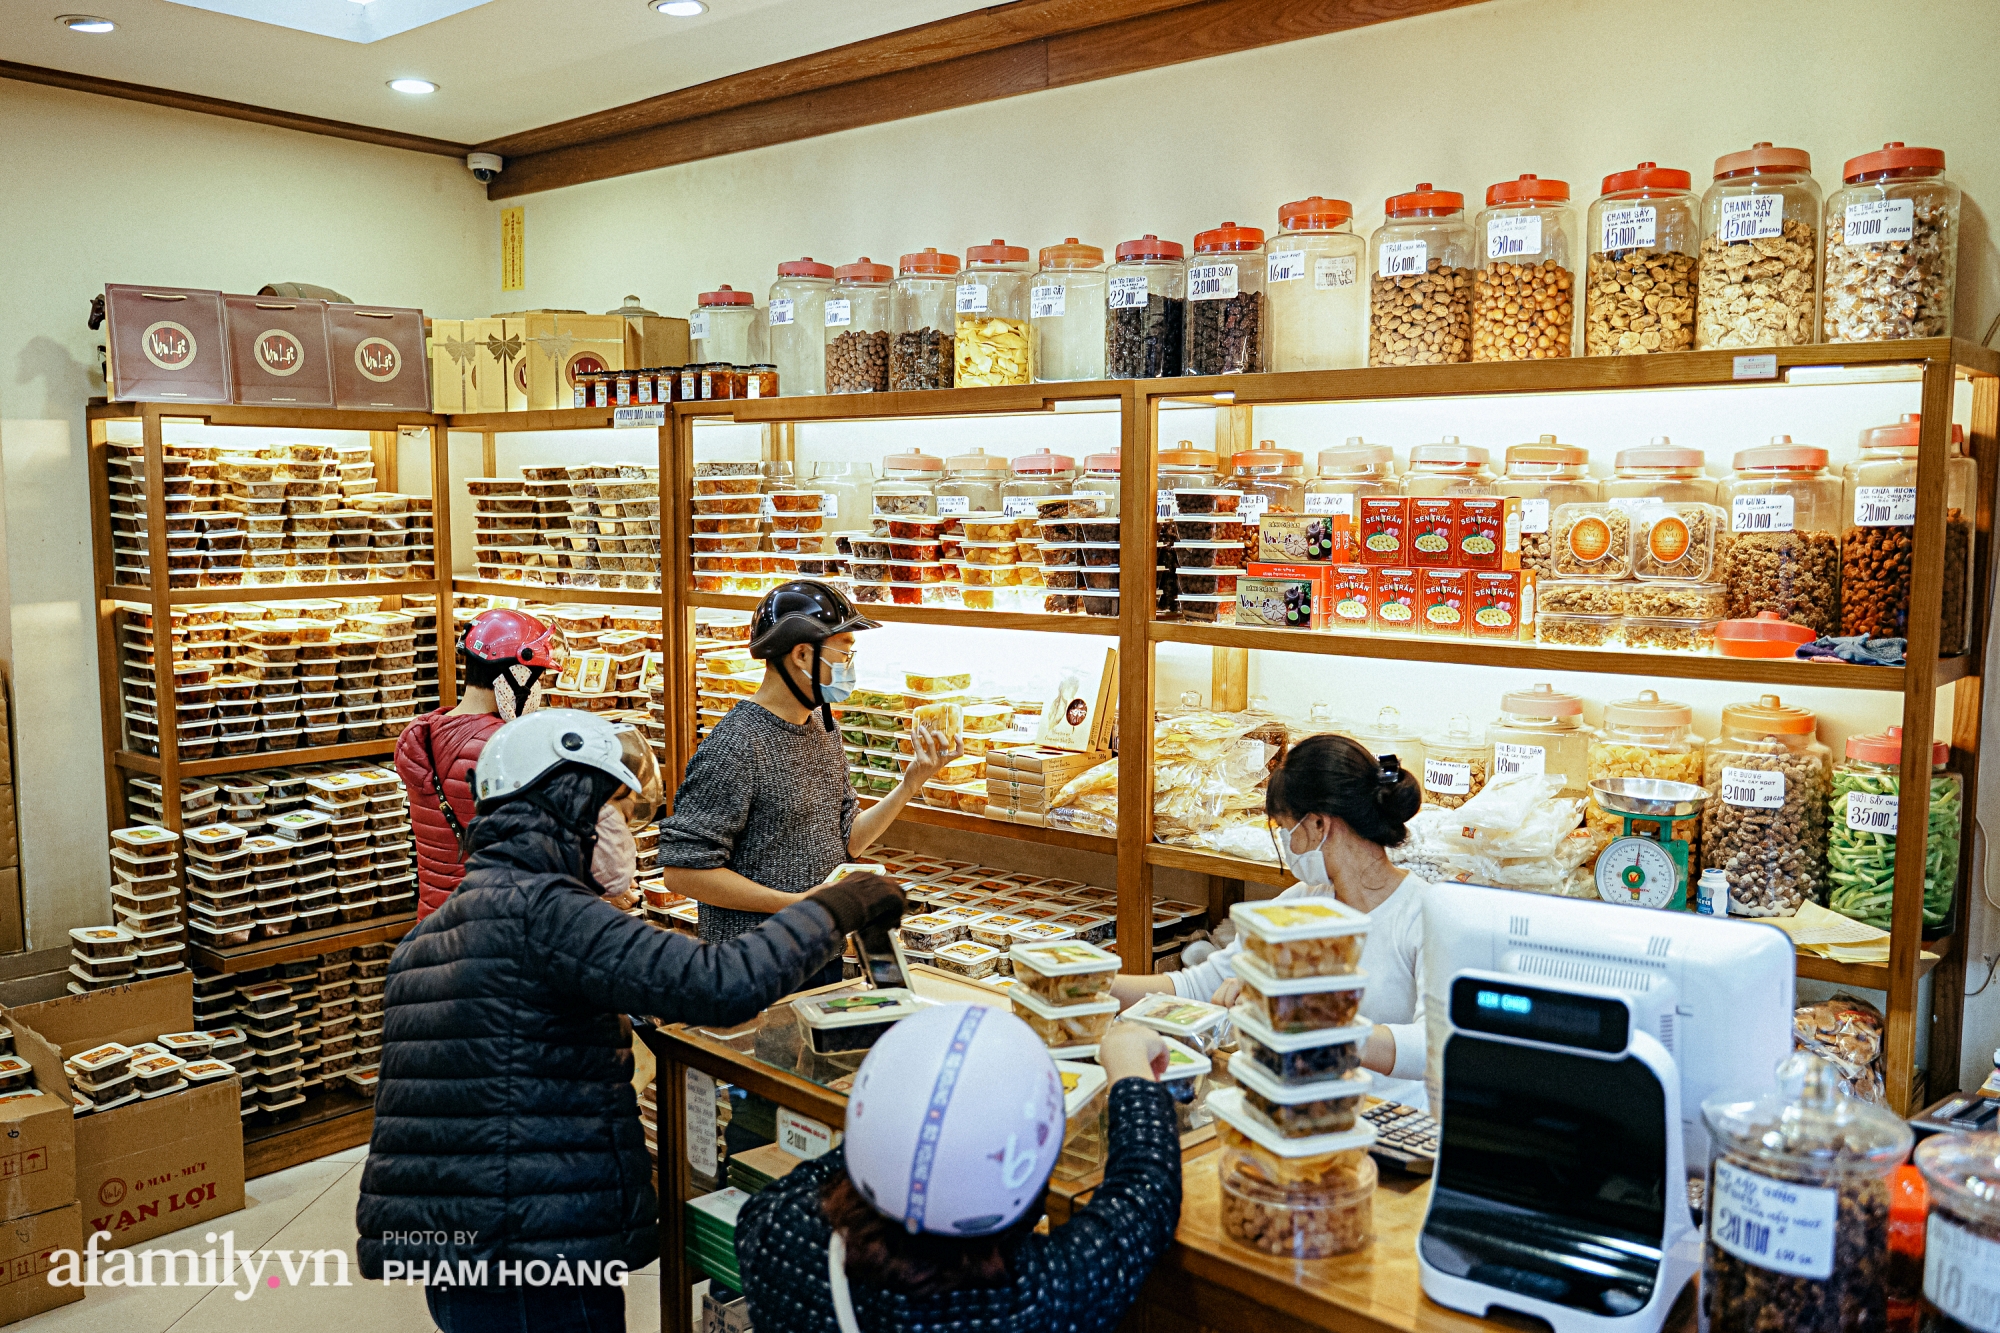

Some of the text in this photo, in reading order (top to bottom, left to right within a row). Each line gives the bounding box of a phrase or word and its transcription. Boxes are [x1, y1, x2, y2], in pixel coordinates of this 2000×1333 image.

[1724, 200, 1752, 214] CHANH
[1607, 211, 1630, 222] CHANH
[1365, 515, 1380, 524] SEN
[1414, 515, 1430, 524] SEN
[1461, 517, 1476, 526] SEN
[1335, 582, 1348, 590] SEN
[1379, 584, 1393, 593] SEN
[1426, 586, 1440, 595] SEN
[1475, 588, 1490, 597] SEN
[1851, 806, 1891, 827] 35000
[147, 1173, 172, 1188] MAI
[90, 1182, 217, 1232] VẠN LỢI
